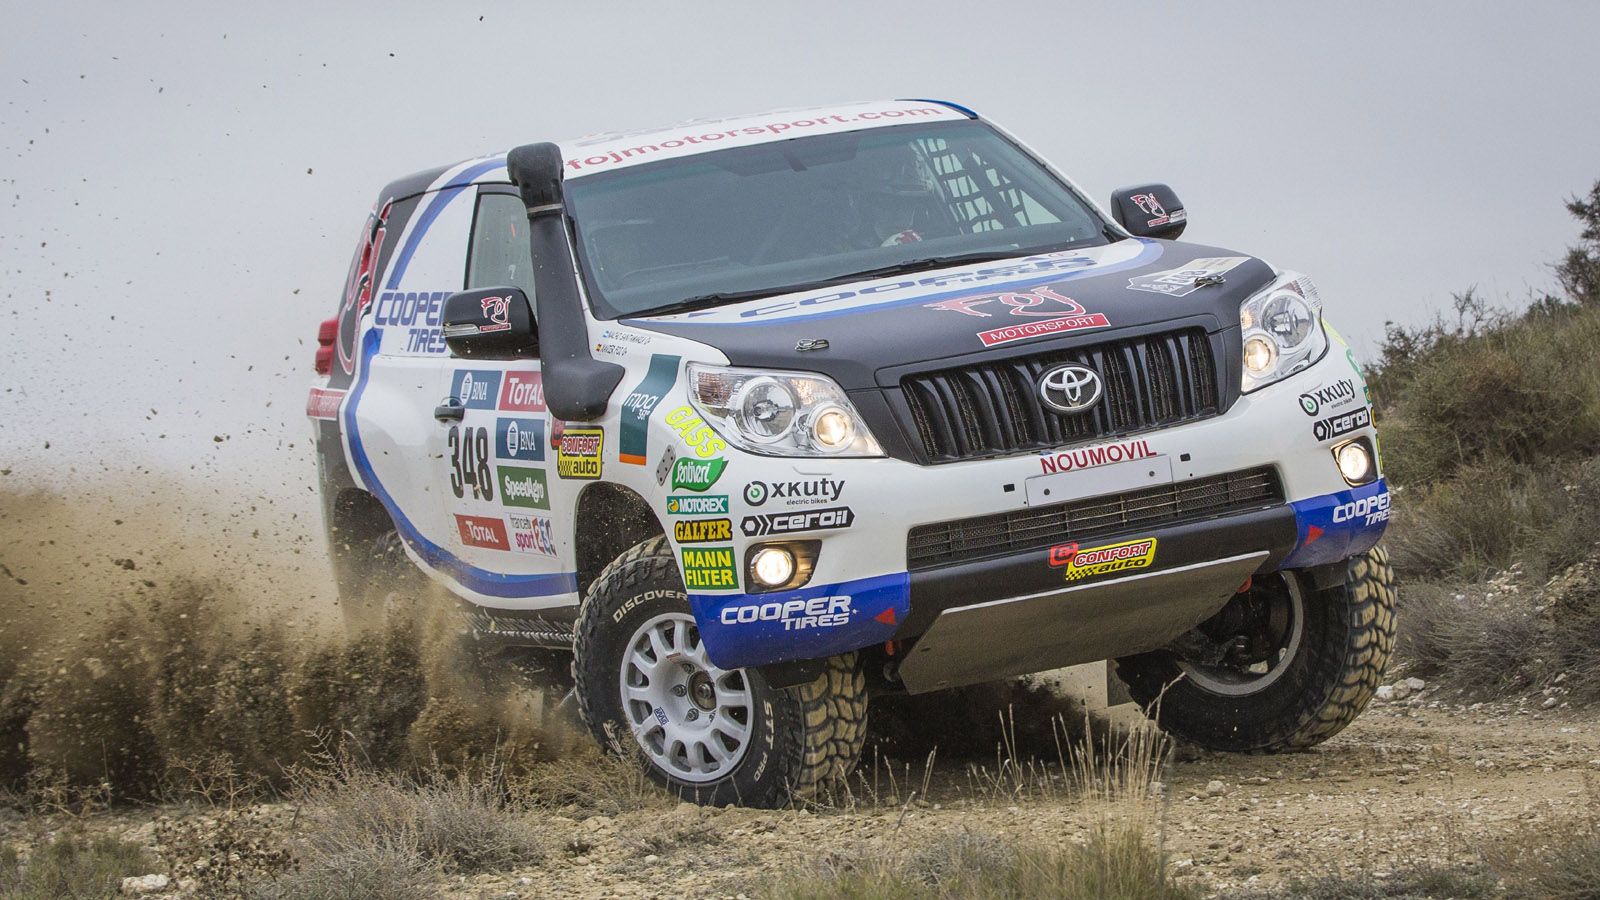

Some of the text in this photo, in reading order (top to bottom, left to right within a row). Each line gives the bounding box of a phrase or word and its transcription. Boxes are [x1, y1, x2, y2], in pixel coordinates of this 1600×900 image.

[567, 108, 942, 170] fojmotorsport.com
[991, 317, 1096, 341] MOTORSPORT
[471, 382, 487, 400] BNA
[520, 431, 536, 451] BNA
[665, 406, 726, 458] GASS
[562, 436, 600, 455] CONFORT
[448, 426, 493, 501] 348
[573, 459, 597, 474] auto
[1041, 441, 1157, 474] NOUMOVIL
[505, 475, 544, 503] SpeedAgro
[680, 498, 725, 512] MOTOREX
[773, 510, 848, 530] ceroil
[675, 521, 732, 541] GALFER
[683, 551, 732, 567] MANN
[1074, 543, 1151, 566] CONFORT
[1098, 559, 1146, 572] auto
[685, 570, 735, 586] FILTER
[721, 595, 852, 625] COOPER
[781, 613, 849, 630] TIRES
[754, 700, 775, 781] STT PRO
